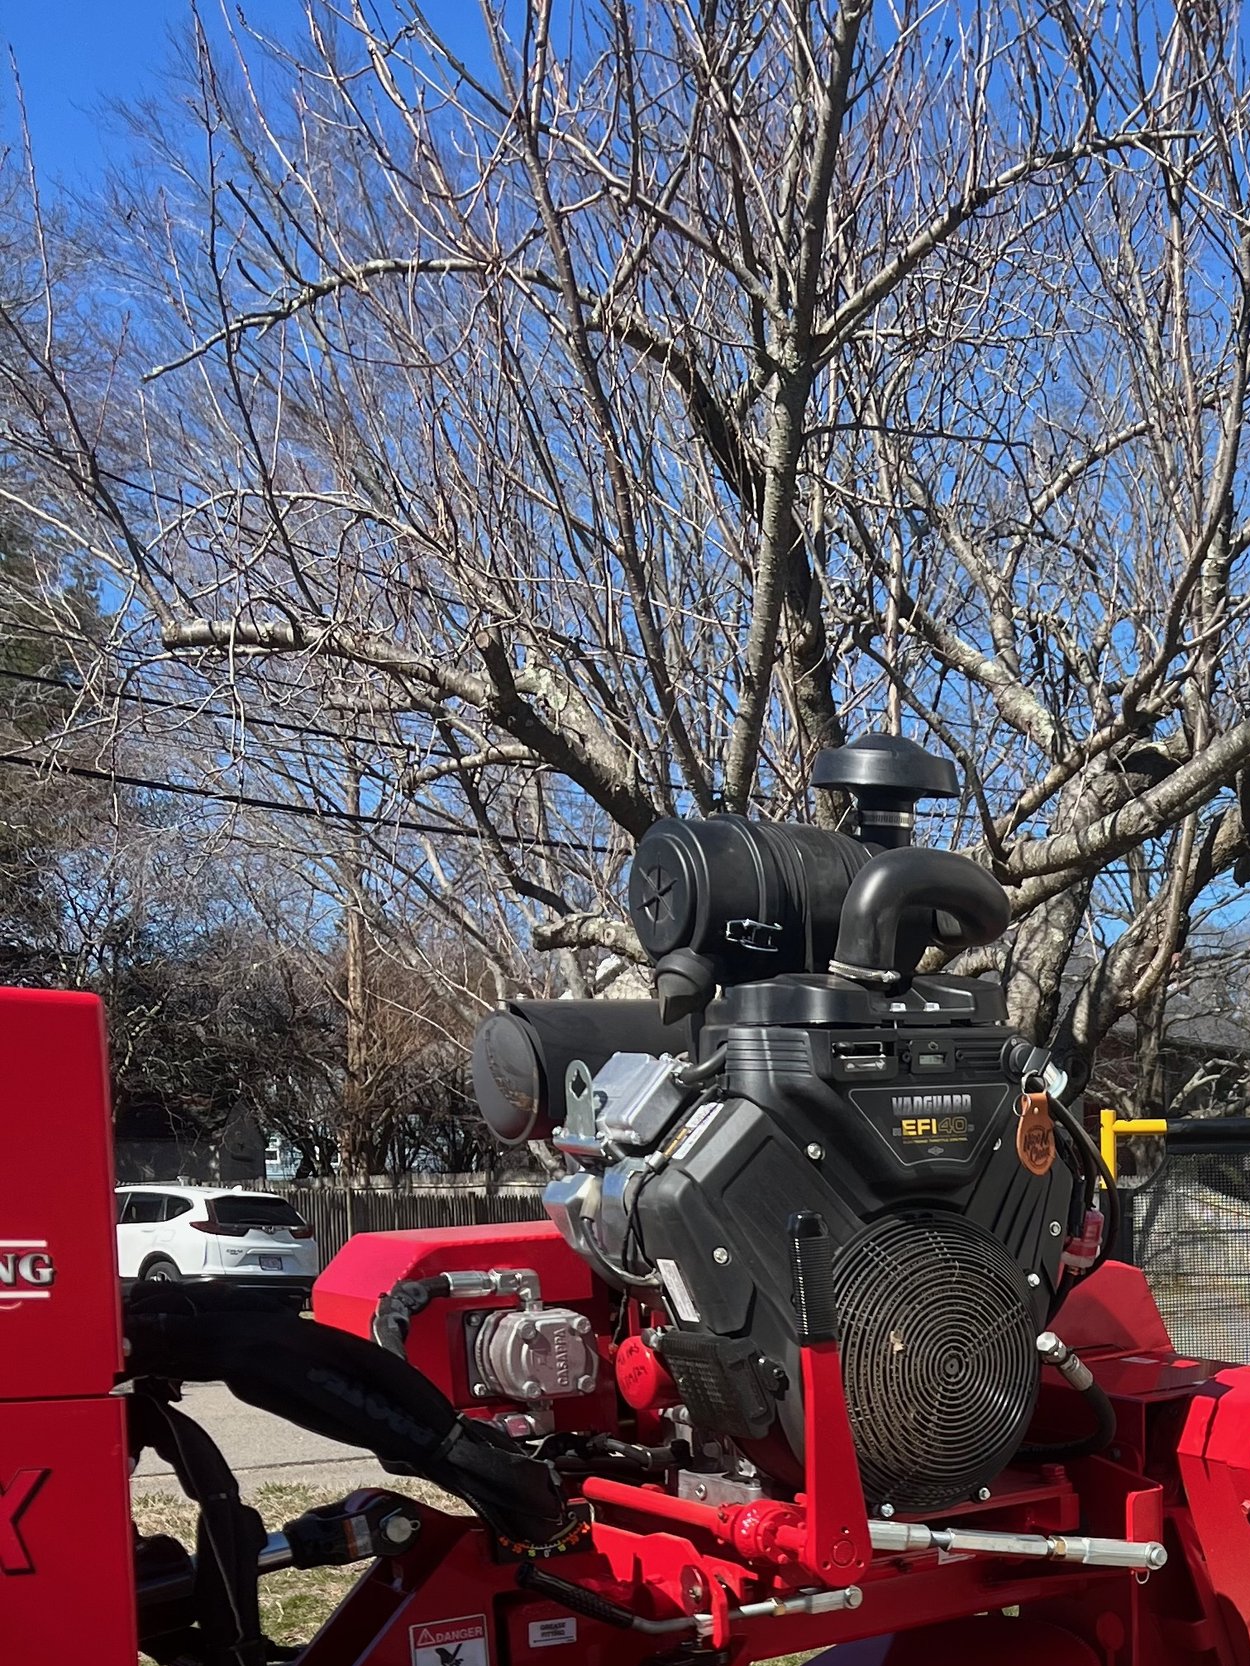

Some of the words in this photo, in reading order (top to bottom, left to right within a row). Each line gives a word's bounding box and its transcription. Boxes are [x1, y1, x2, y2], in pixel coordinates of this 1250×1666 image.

[892, 1094, 972, 1115] VANGUARD
[554, 1327, 569, 1386] CASAPPA
[435, 1626, 483, 1643] DANGER
